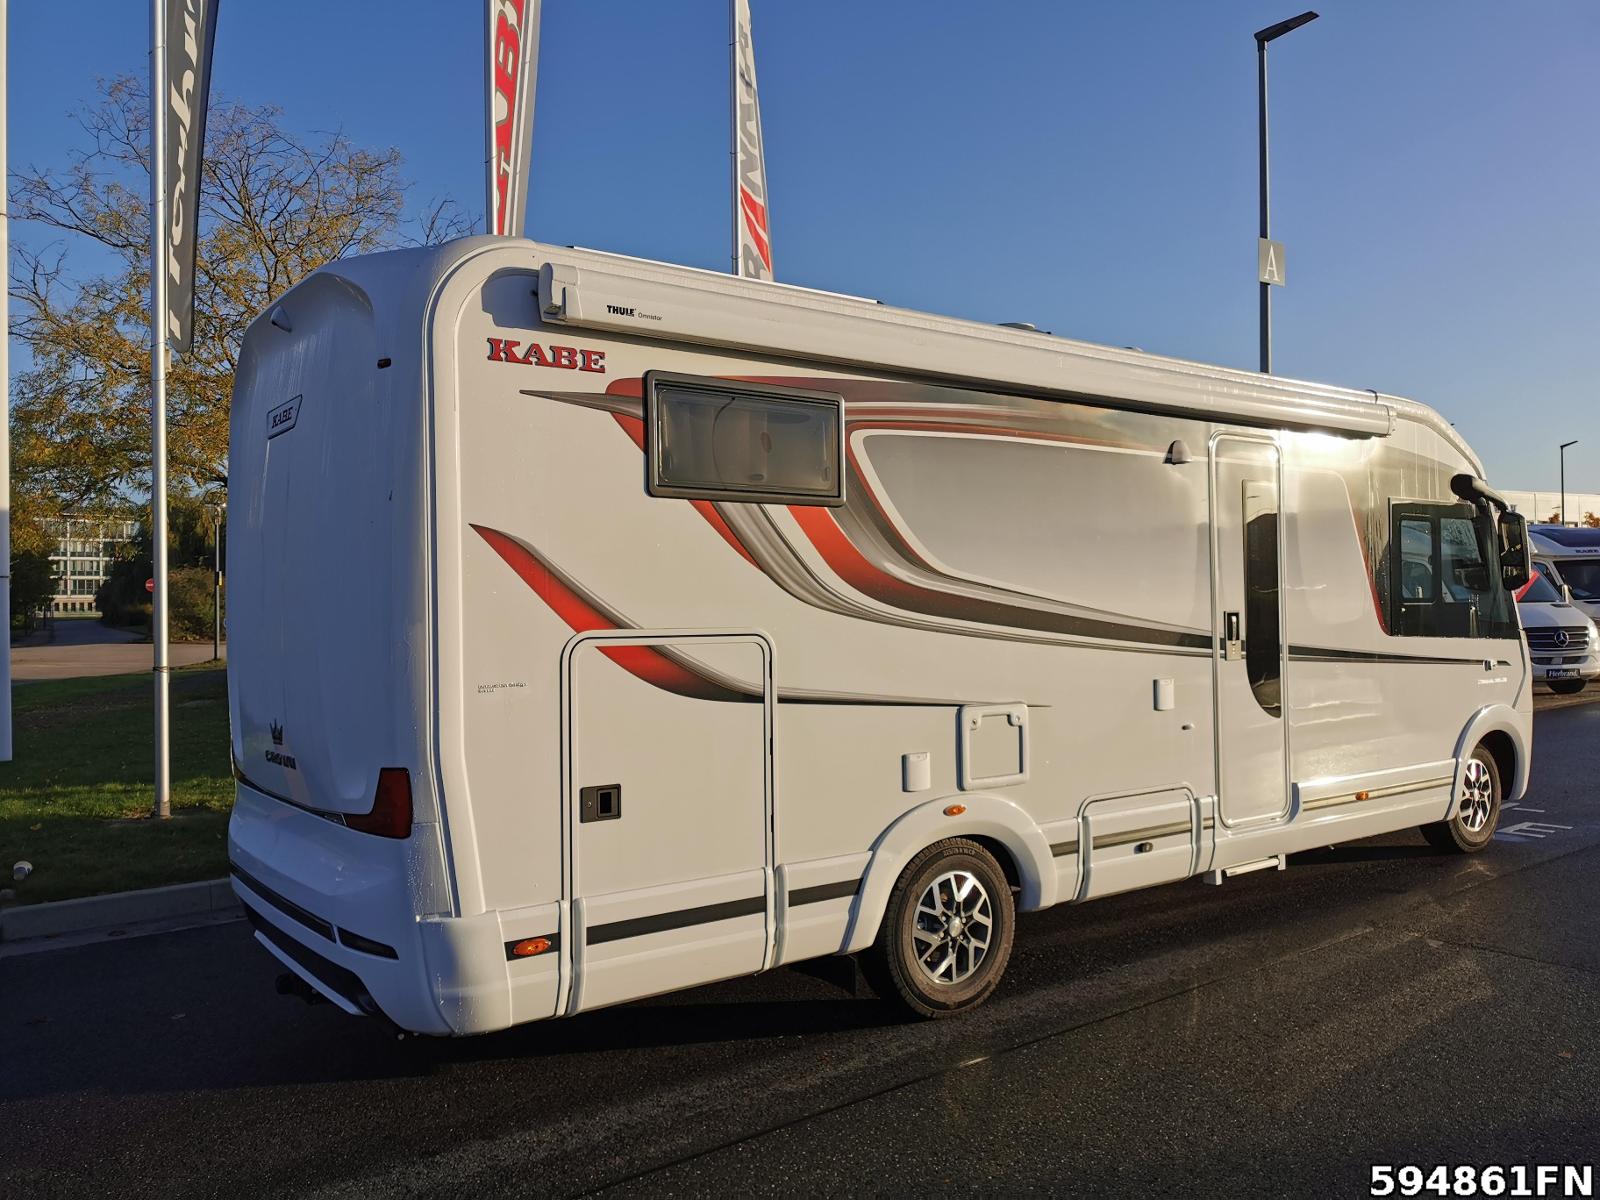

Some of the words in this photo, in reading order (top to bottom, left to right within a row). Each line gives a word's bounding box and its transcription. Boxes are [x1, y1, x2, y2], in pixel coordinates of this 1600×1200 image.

[1263, 244, 1281, 282] A
[606, 304, 635, 318] THULE
[487, 337, 606, 374] KABE
